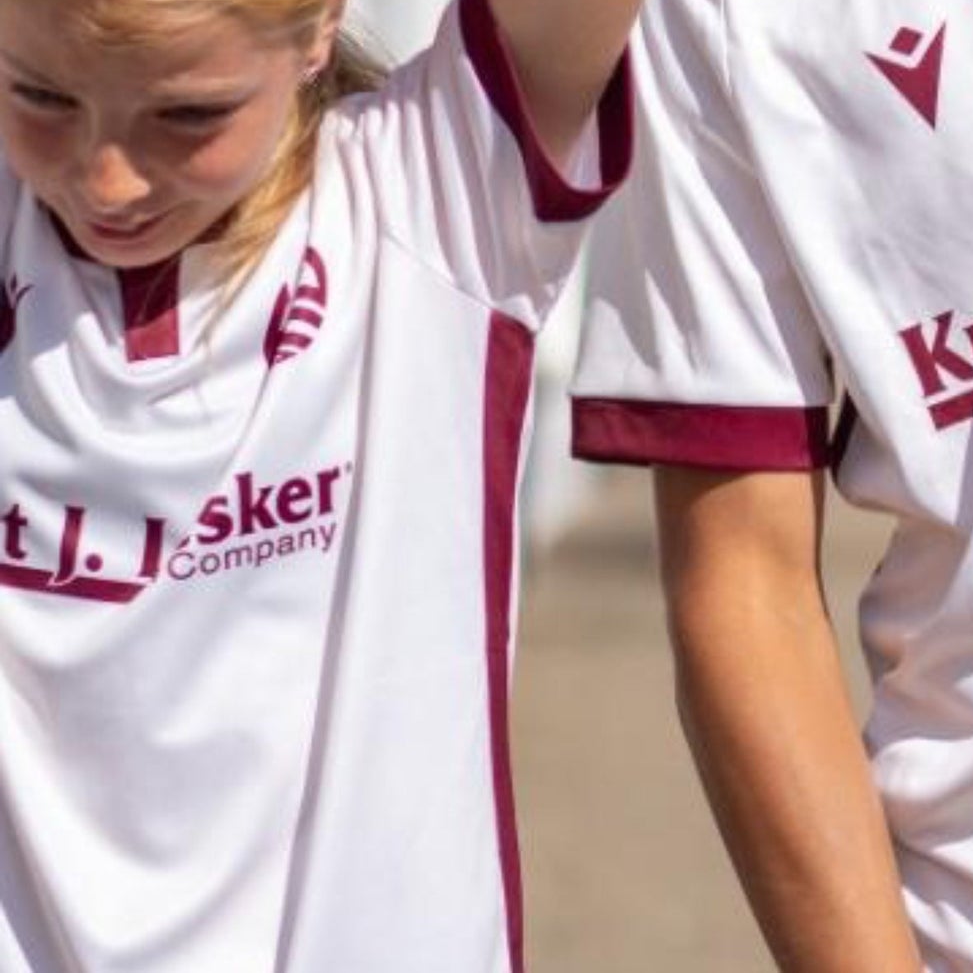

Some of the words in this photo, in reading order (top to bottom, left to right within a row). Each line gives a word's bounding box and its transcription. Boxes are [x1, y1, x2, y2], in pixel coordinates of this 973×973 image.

[50, 505, 103, 584] J.
[138, 469, 340, 578] Lsker
[167, 522, 337, 580] Company
